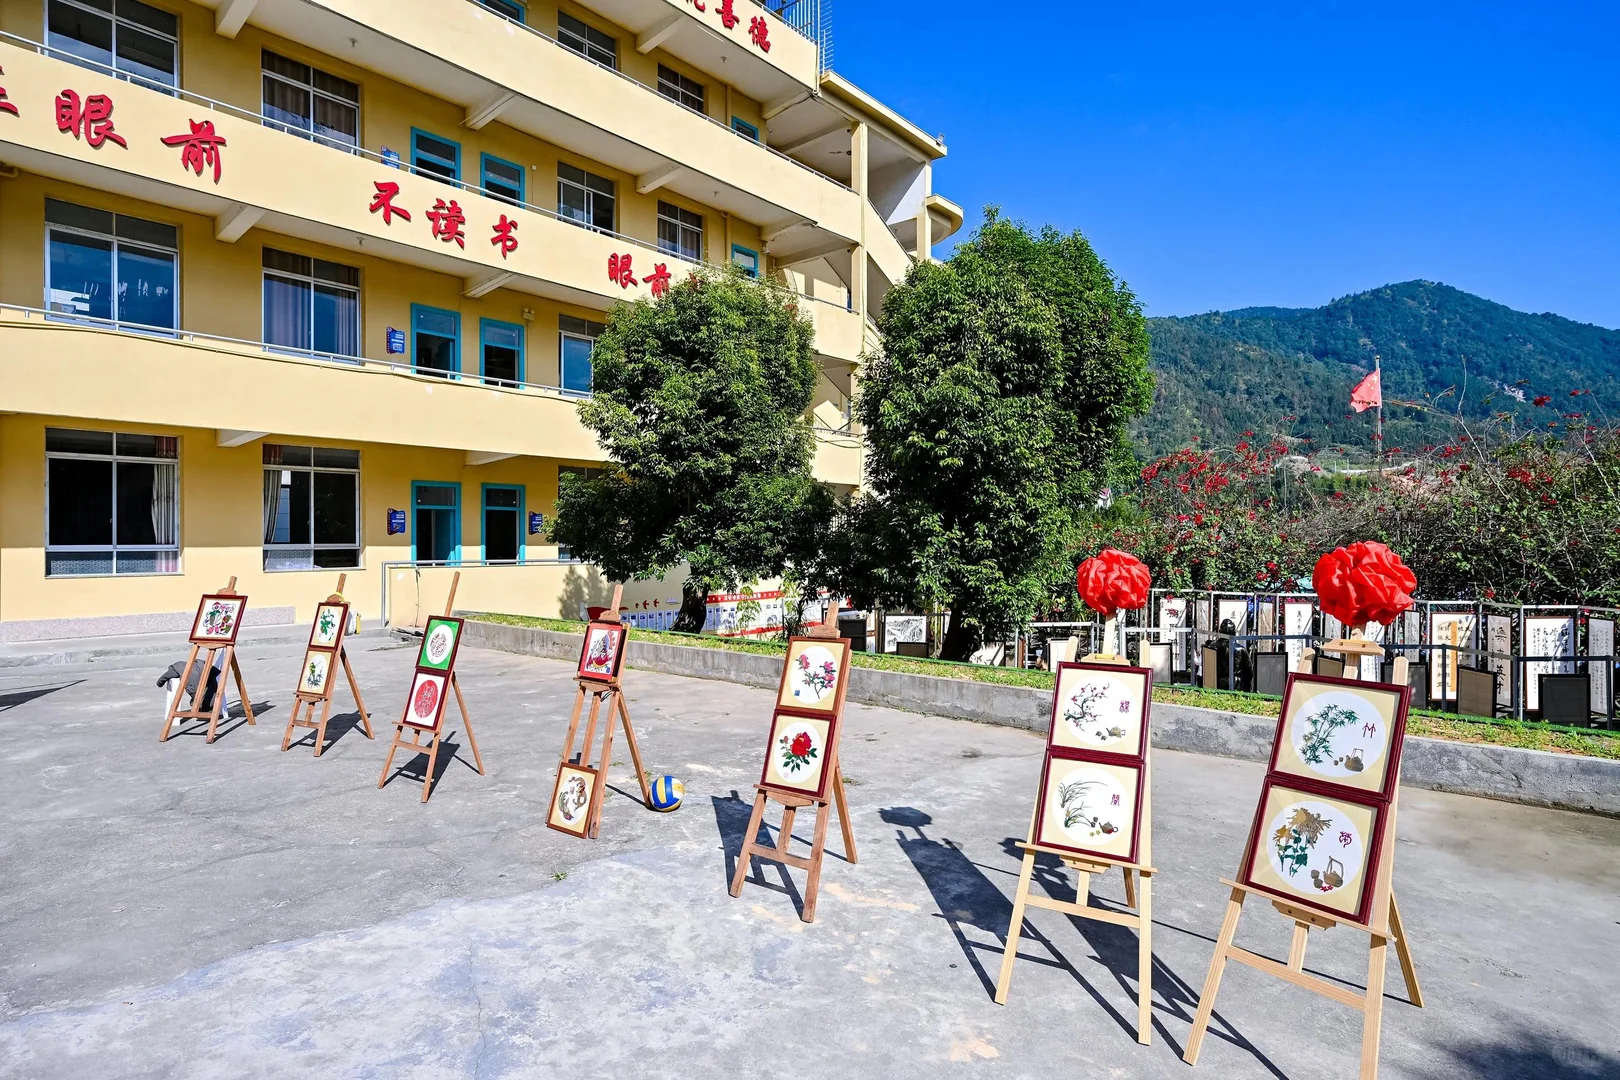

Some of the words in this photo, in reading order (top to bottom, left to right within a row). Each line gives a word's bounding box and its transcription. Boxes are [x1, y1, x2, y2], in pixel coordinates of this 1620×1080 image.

[685, 0, 771, 53] 善德
[0, 65, 227, 184] 眼前
[369, 181, 518, 259] 不读书
